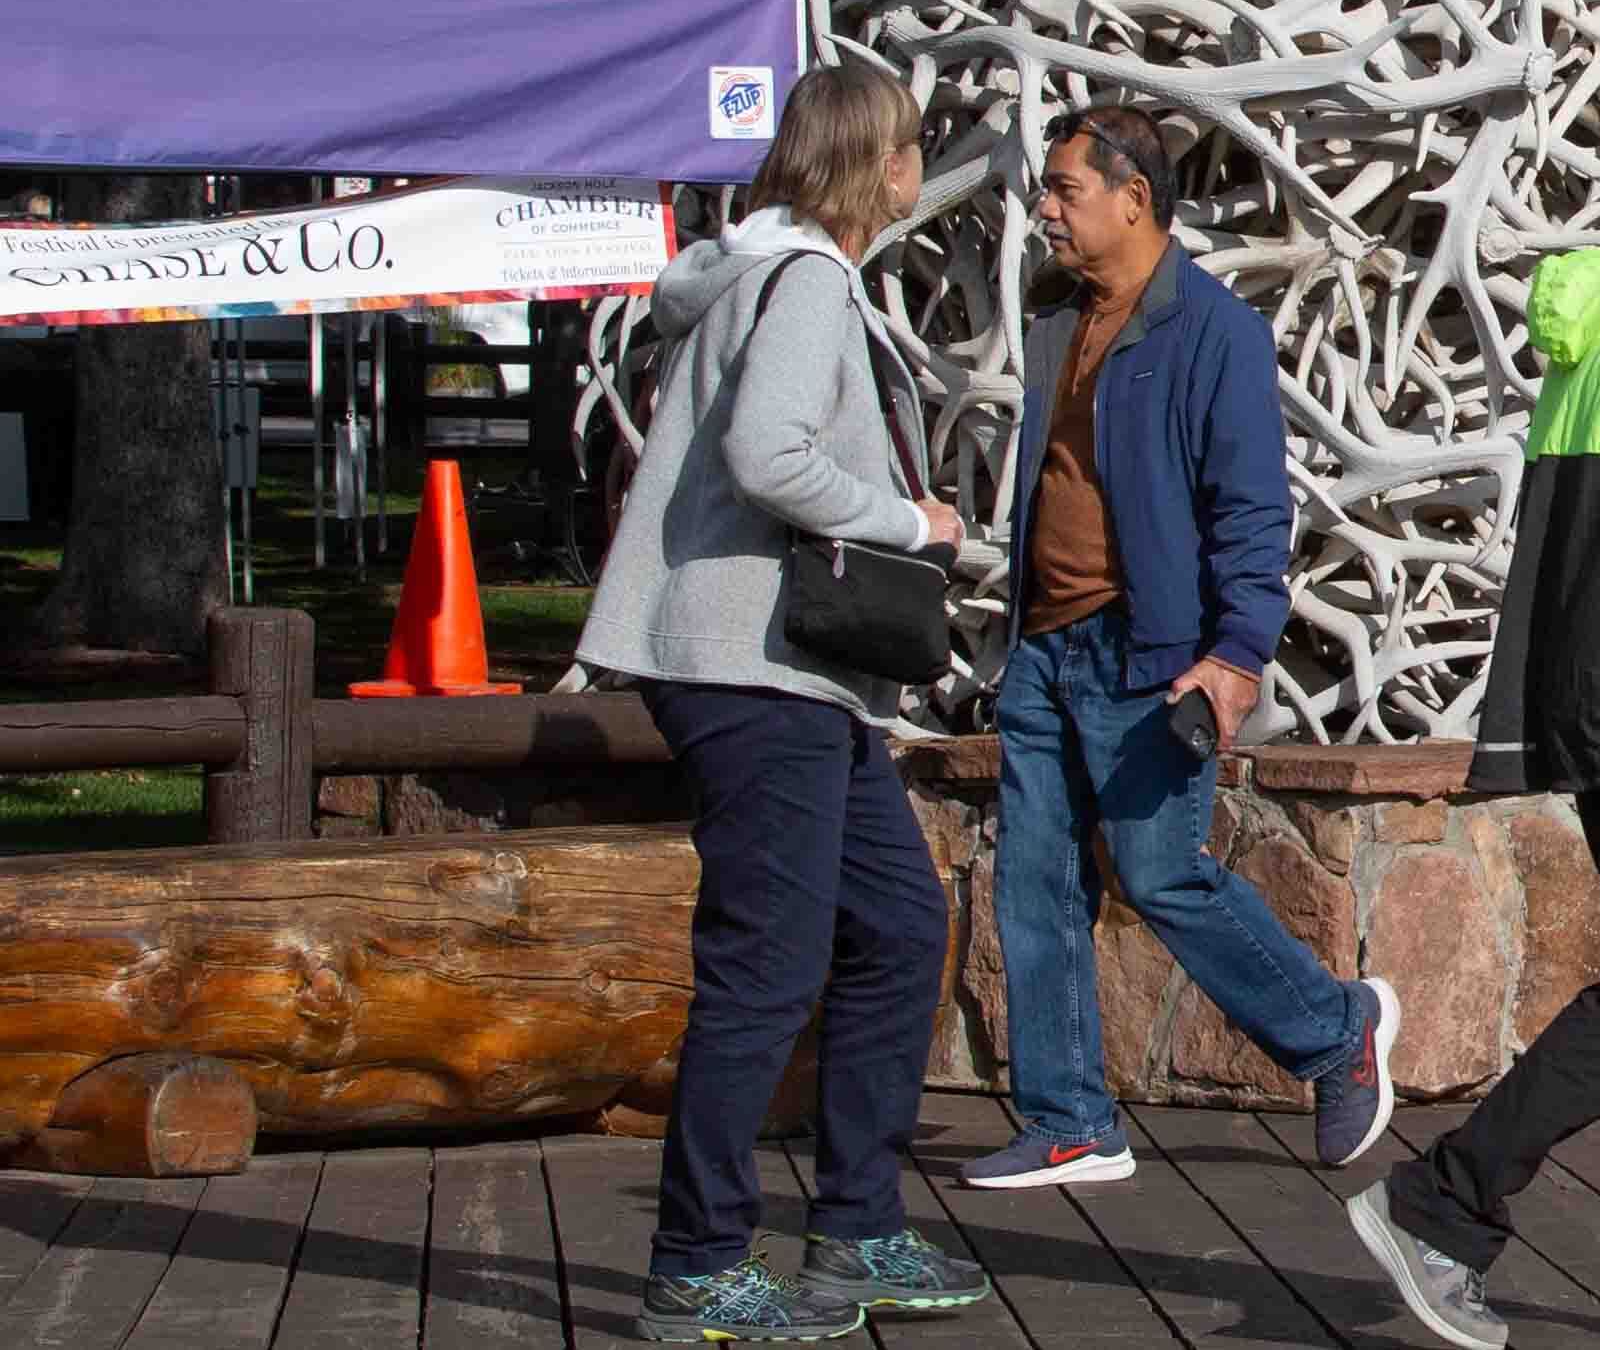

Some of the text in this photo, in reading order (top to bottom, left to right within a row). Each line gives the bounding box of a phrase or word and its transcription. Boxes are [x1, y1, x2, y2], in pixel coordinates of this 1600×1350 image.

[496, 195, 657, 227] CHAMBER
[3, 234, 101, 253] Festival
[104, 235, 129, 249] is
[133, 222, 260, 249] presented
[531, 221, 620, 235] OF COMMERCE
[240, 234, 289, 276] &
[560, 261, 632, 281] Information
